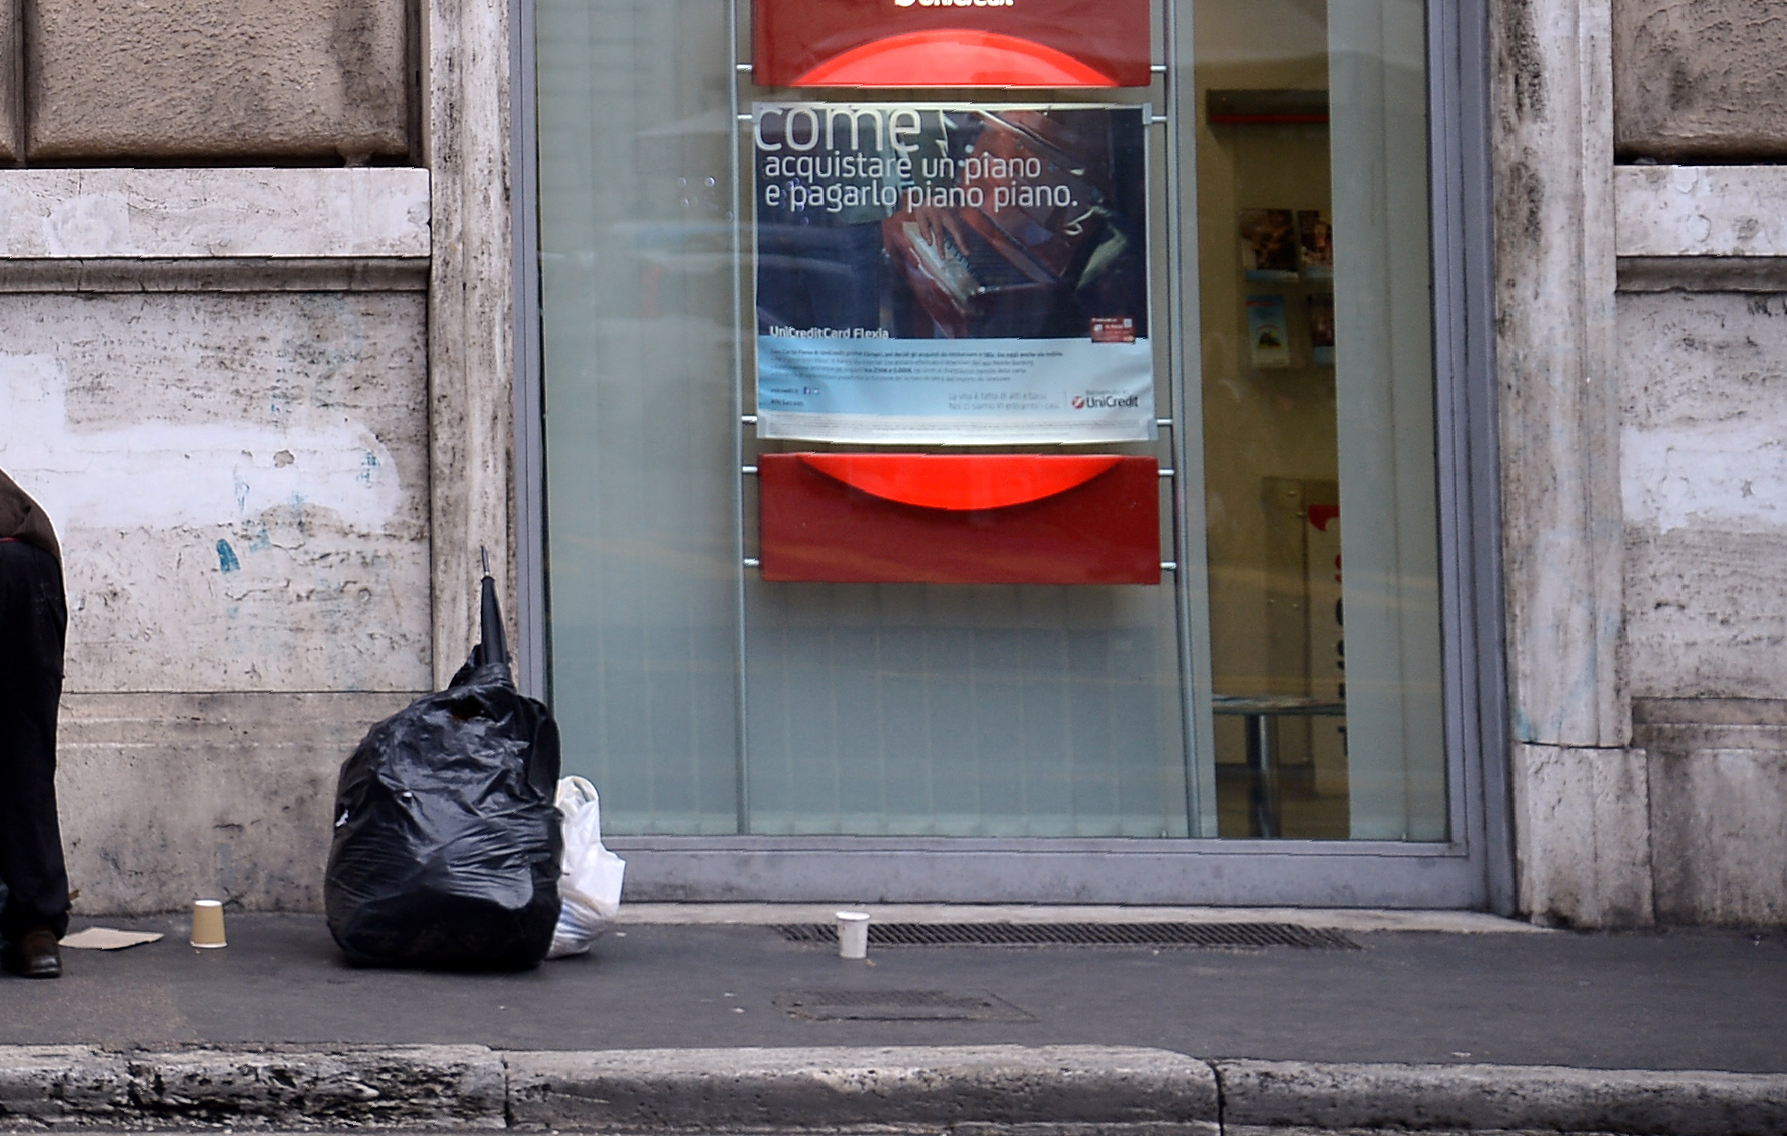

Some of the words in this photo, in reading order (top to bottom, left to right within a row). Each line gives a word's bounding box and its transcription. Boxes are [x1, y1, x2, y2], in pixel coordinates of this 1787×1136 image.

[755, 107, 922, 152] come
[764, 150, 912, 185] acquistare
[921, 157, 955, 179] un
[964, 151, 1041, 185] piano
[765, 183, 781, 207] e
[790, 179, 899, 213] pagarlo
[907, 180, 985, 213] piano
[993, 180, 1079, 213] piano.
[1086, 395, 1139, 409] UniCredit
